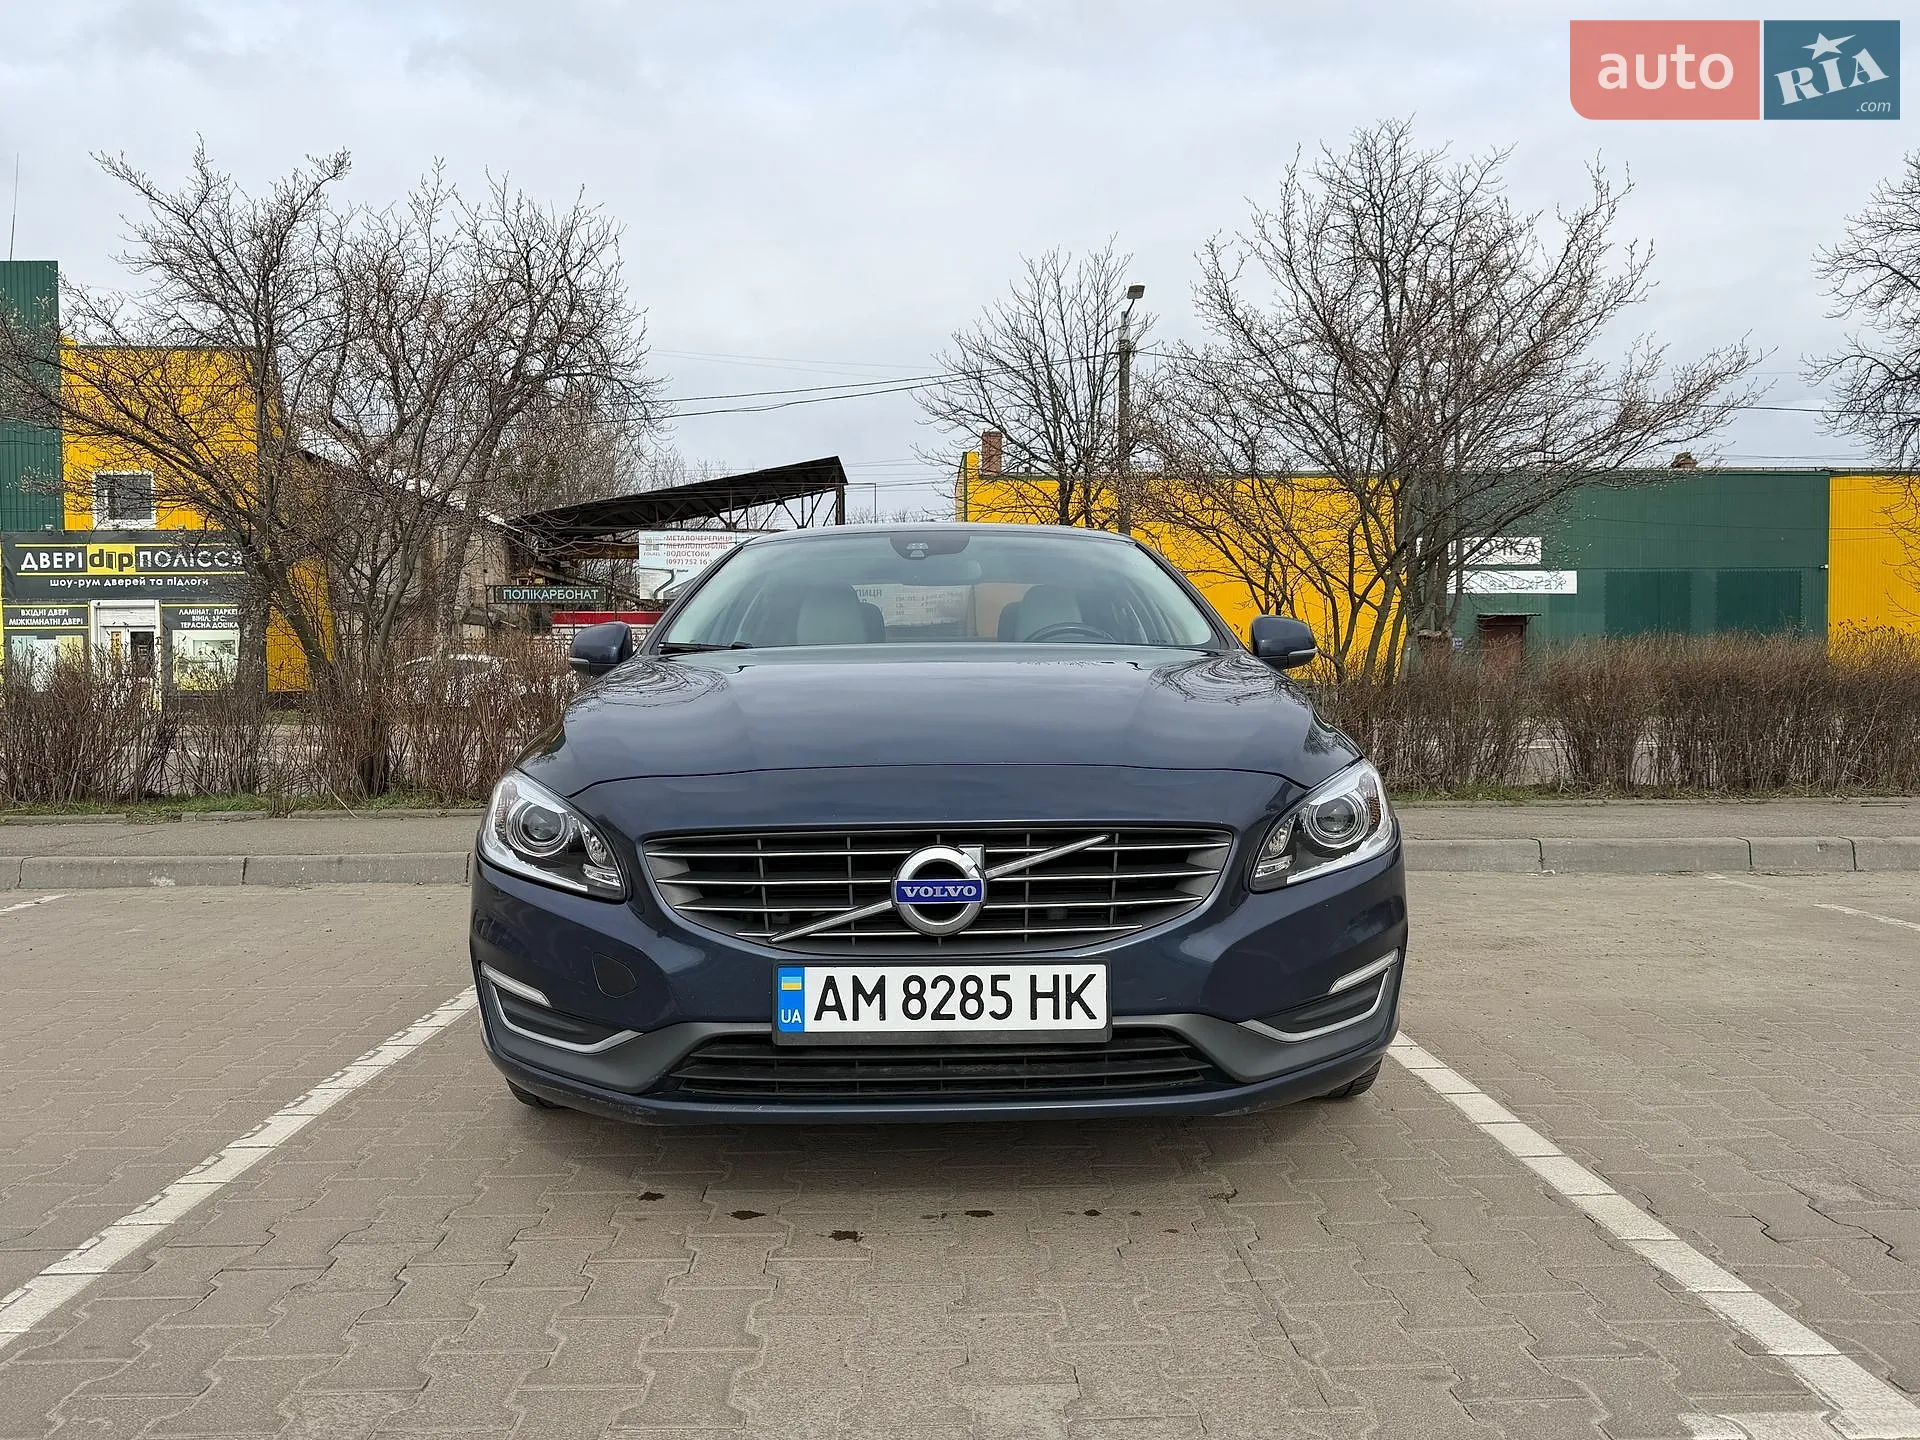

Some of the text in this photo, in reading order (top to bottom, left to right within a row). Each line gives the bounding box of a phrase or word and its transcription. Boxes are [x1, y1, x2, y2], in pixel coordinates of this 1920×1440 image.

[20, 552, 83, 570] ДВЕРІ
[50, 579, 101, 587] шоу-рум
[103, 577, 146, 586] дверей
[166, 577, 209, 586] підлоги
[503, 588, 599, 600] ПОЛІКАРБОНАТ
[901, 885, 977, 898] VOLVO
[813, 973, 1098, 1021] AM 8285 HK
[781, 1009, 802, 1024] UA
